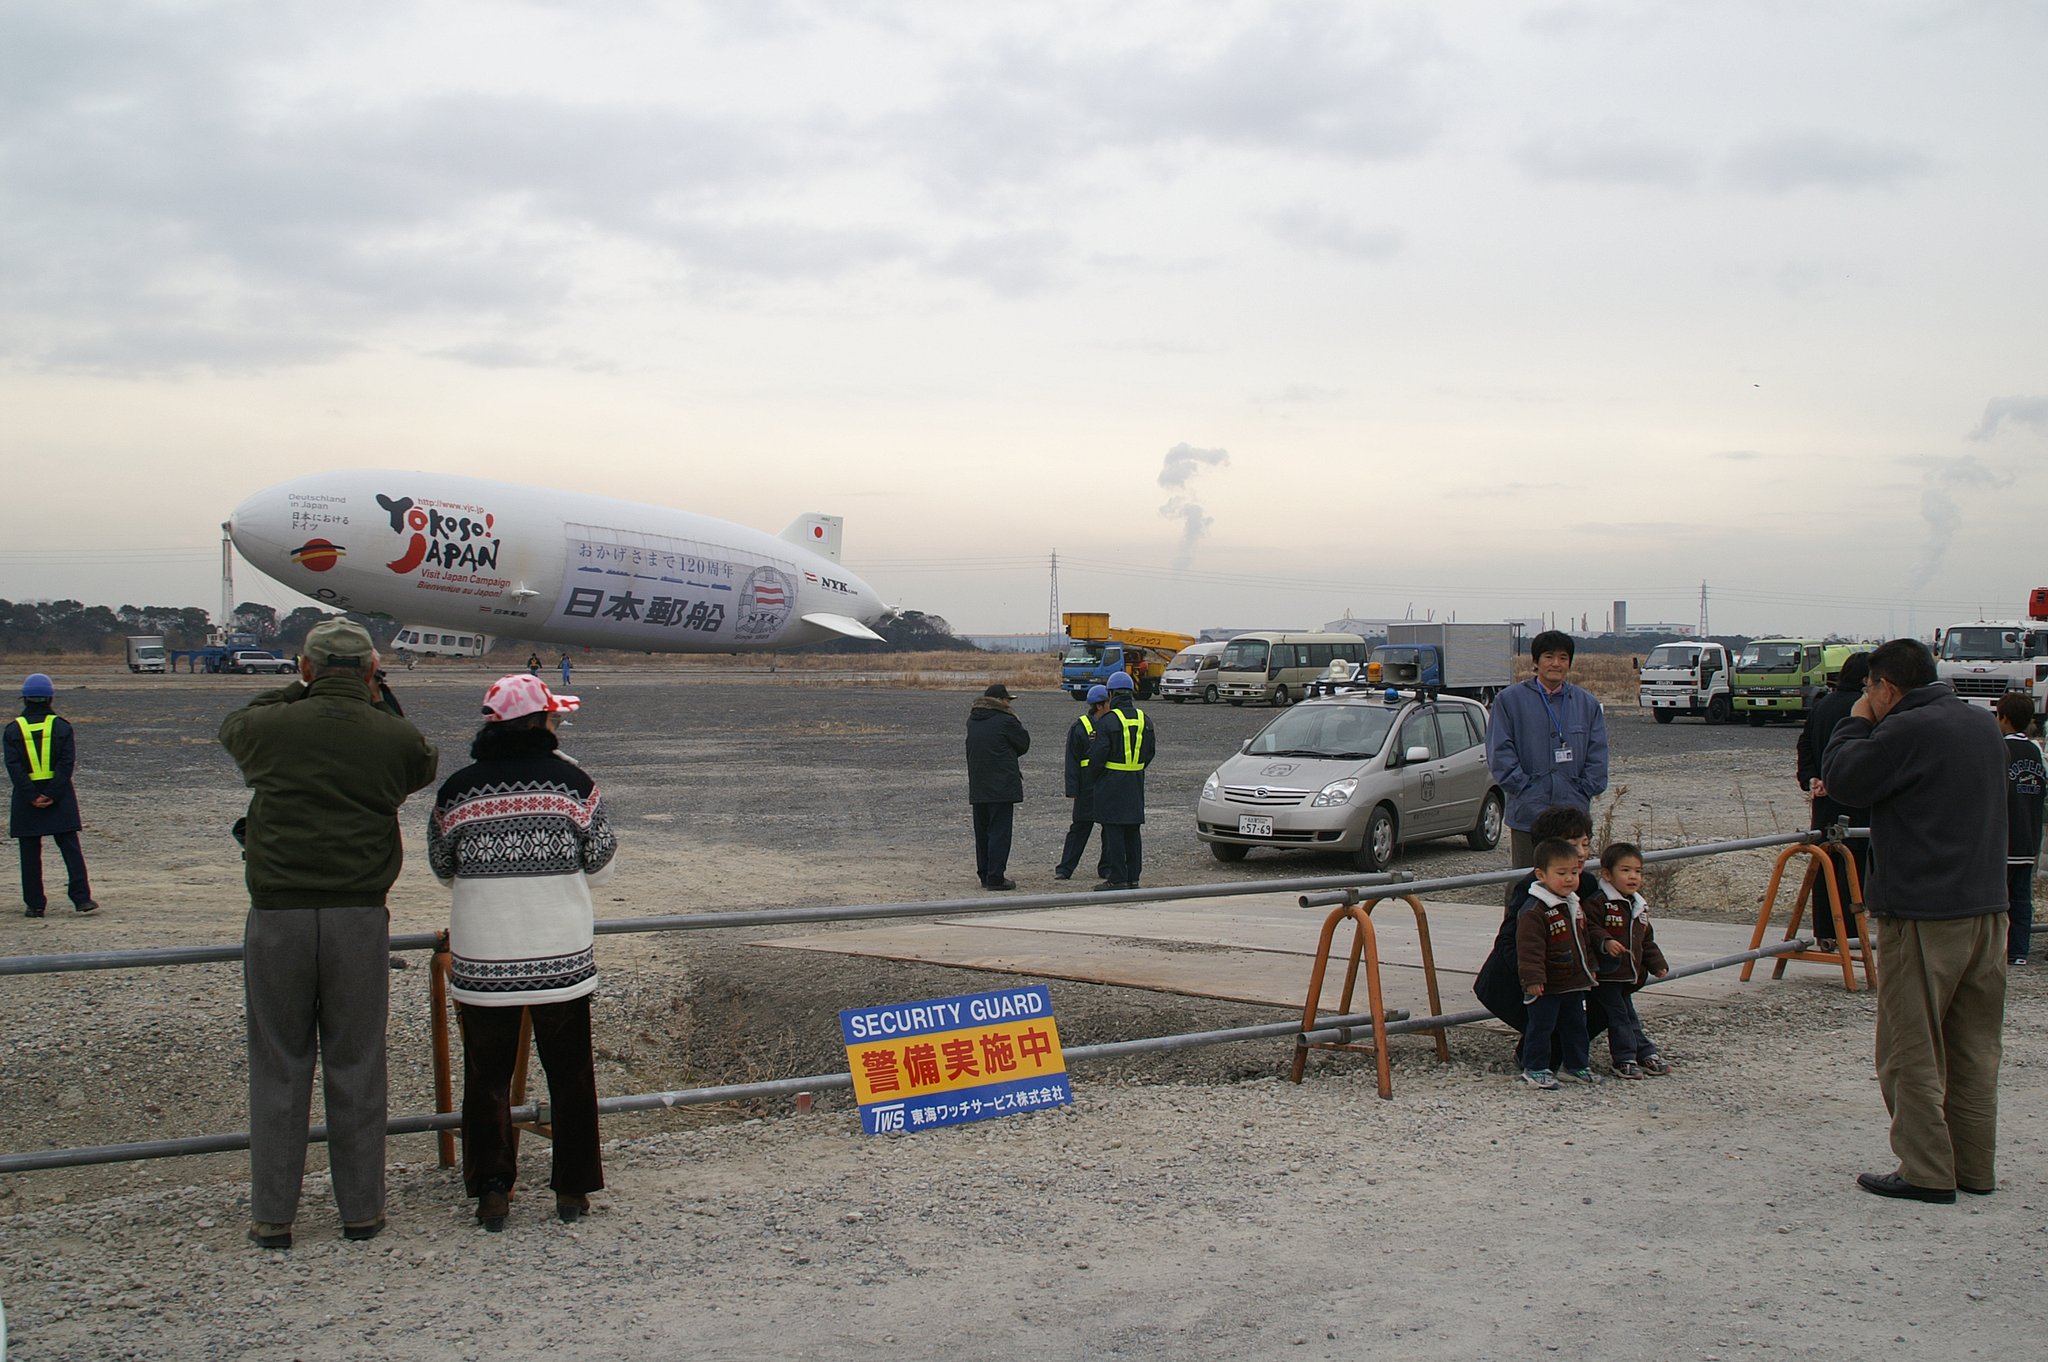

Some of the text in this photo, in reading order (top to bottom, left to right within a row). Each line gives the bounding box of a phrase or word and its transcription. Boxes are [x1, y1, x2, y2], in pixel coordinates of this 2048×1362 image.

[289, 493, 346, 503] Deutschland
[301, 501, 329, 510] Japan
[418, 498, 485, 515] http://www.vjc.jp
[292, 511, 350, 525] 日本における
[292, 520, 318, 531] ドイツ
[386, 532, 501, 574] JAPAN
[579, 543, 735, 579] おかげさまで120周年
[421, 568, 511, 589] Visit Japan Campaign
[822, 577, 848, 592] NYK
[417, 581, 461, 594] Bienvenue
[473, 589, 503, 599] Japon!
[563, 587, 726, 632] 日本郵船
[747, 613, 778, 624] NYK
[851, 992, 1043, 1038] SECURITY GUARD
[861, 1026, 1052, 1094] 警備実施中
[910, 1085, 1065, 1125] 東海ワッチサービス株式会社
[871, 1103, 905, 1133] TWS
